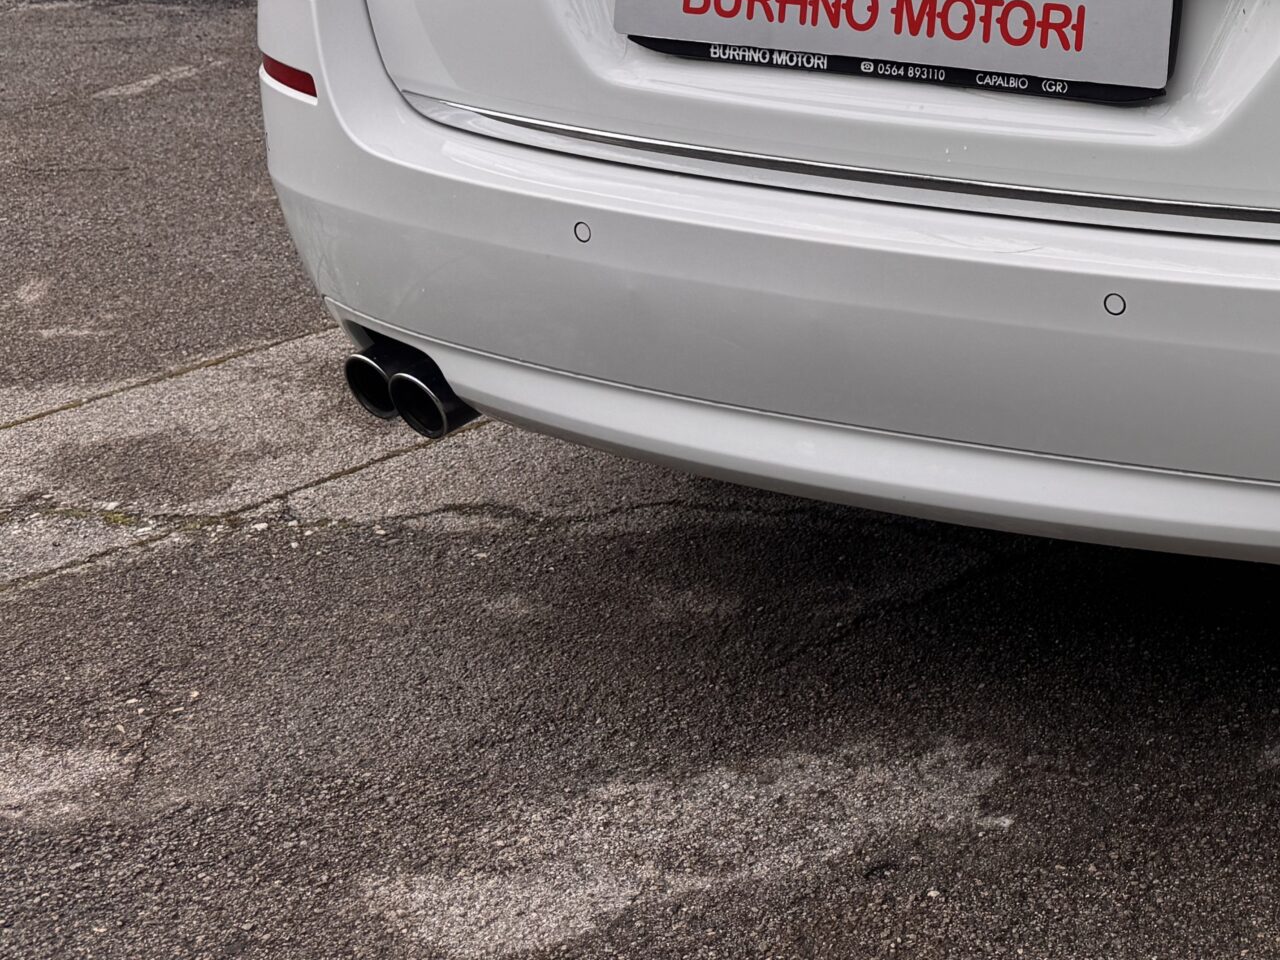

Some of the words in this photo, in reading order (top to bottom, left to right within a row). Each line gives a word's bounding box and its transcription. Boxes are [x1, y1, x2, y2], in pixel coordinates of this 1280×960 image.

[709, 44, 770, 64] BURANO
[772, 50, 828, 70] MOTORI
[877, 63, 905, 77] 0564
[907, 66, 946, 81] 893110
[975, 73, 1029, 90] CAPALBIO
[1041, 79, 1069, 94] (GR)
